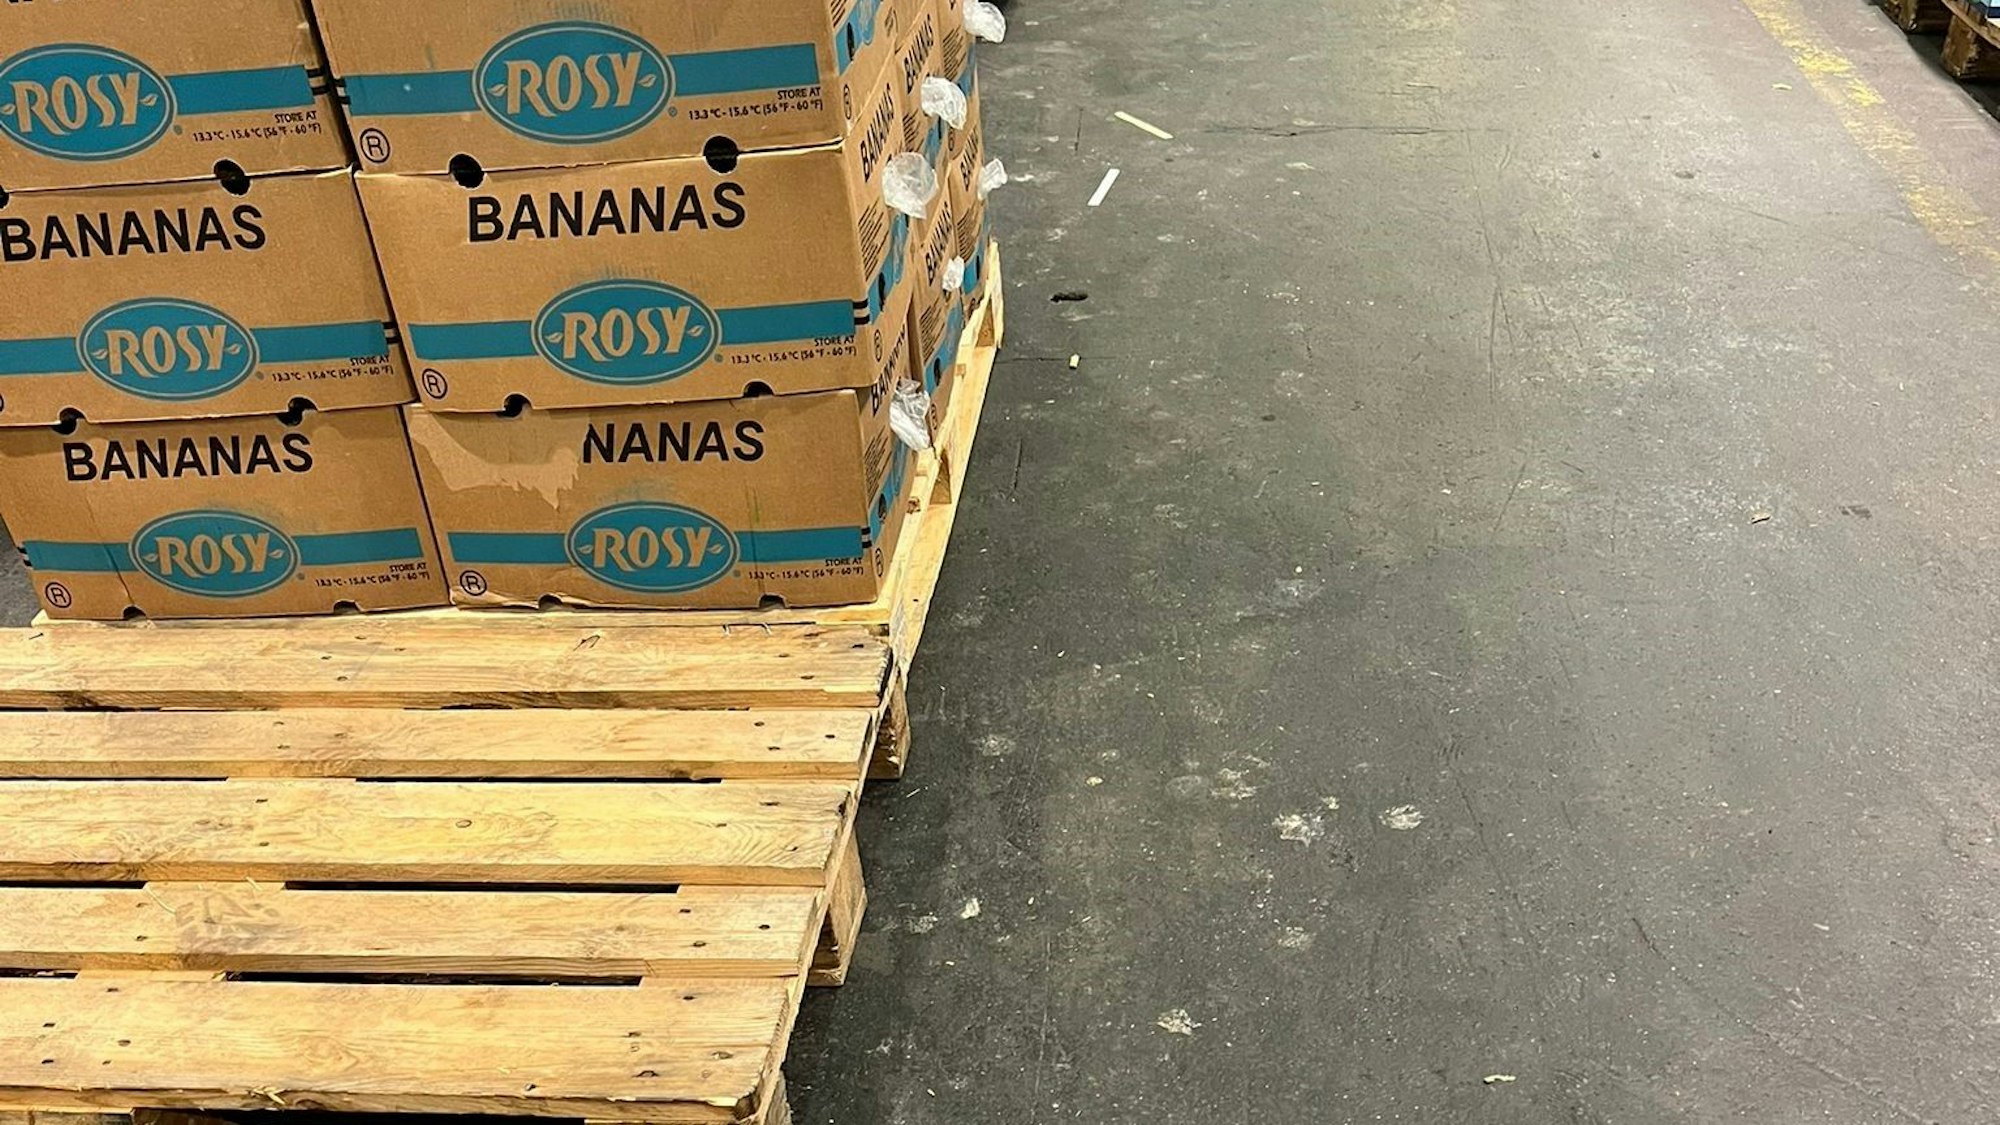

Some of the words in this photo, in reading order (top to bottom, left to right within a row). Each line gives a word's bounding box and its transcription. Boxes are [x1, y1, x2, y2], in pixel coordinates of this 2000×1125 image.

[8, 72, 140, 135] ROSY
[504, 52, 641, 118] ROSY
[777, 88, 807, 100] STORE
[809, 87, 821, 97] AT
[274, 111, 303, 123] STORE
[306, 111, 317, 120] AT
[0, 205, 266, 261] BANANAS
[469, 182, 745, 242] BANANAS
[105, 325, 227, 377] ROSY
[561, 306, 690, 361] ROSY
[814, 336, 841, 347] STORE
[844, 336, 855, 344] AT
[350, 357, 377, 366] STORE
[63, 434, 313, 481] BANANAS
[154, 533, 270, 578] ROSY
[593, 526, 711, 572] ROSY
